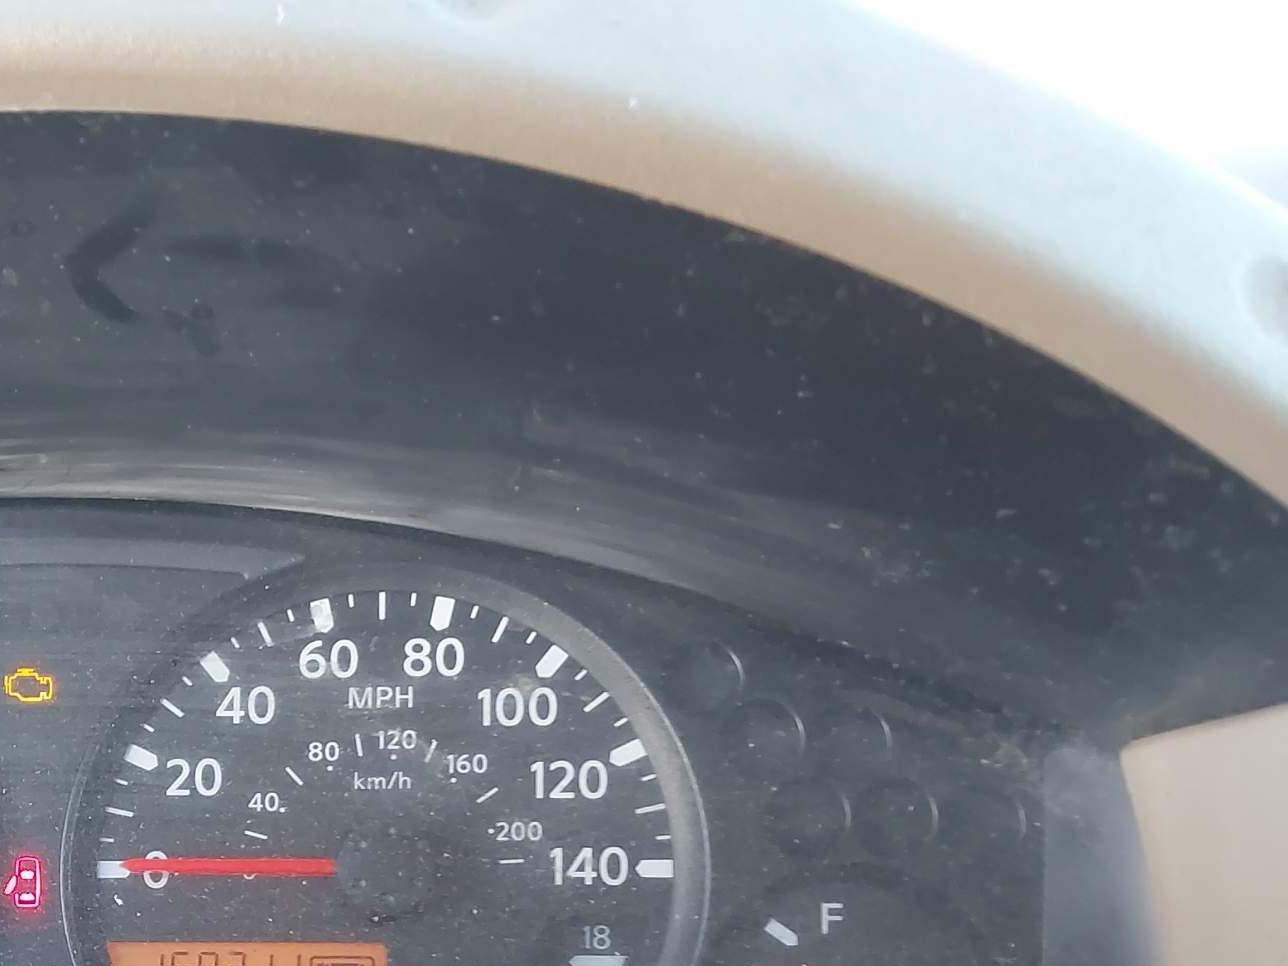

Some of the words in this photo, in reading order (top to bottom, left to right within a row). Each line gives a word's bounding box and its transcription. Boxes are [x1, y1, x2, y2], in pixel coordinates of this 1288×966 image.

[298, 638, 359, 679] 60
[402, 637, 465, 678] 80
[215, 685, 276, 725] 40
[347, 686, 415, 709] MPH
[476, 687, 559, 728] 100
[307, 740, 341, 763] 80
[377, 729, 418, 751] 120
[165, 757, 223, 798] 20
[446, 752, 489, 775] 160
[352, 770, 413, 793] km/h
[529, 759, 609, 800] 120
[247, 792, 280, 813] 40
[494, 821, 544, 842] 200
[548, 846, 629, 887] 140
[820, 902, 845, 934] F
[582, 925, 611, 950] 18
